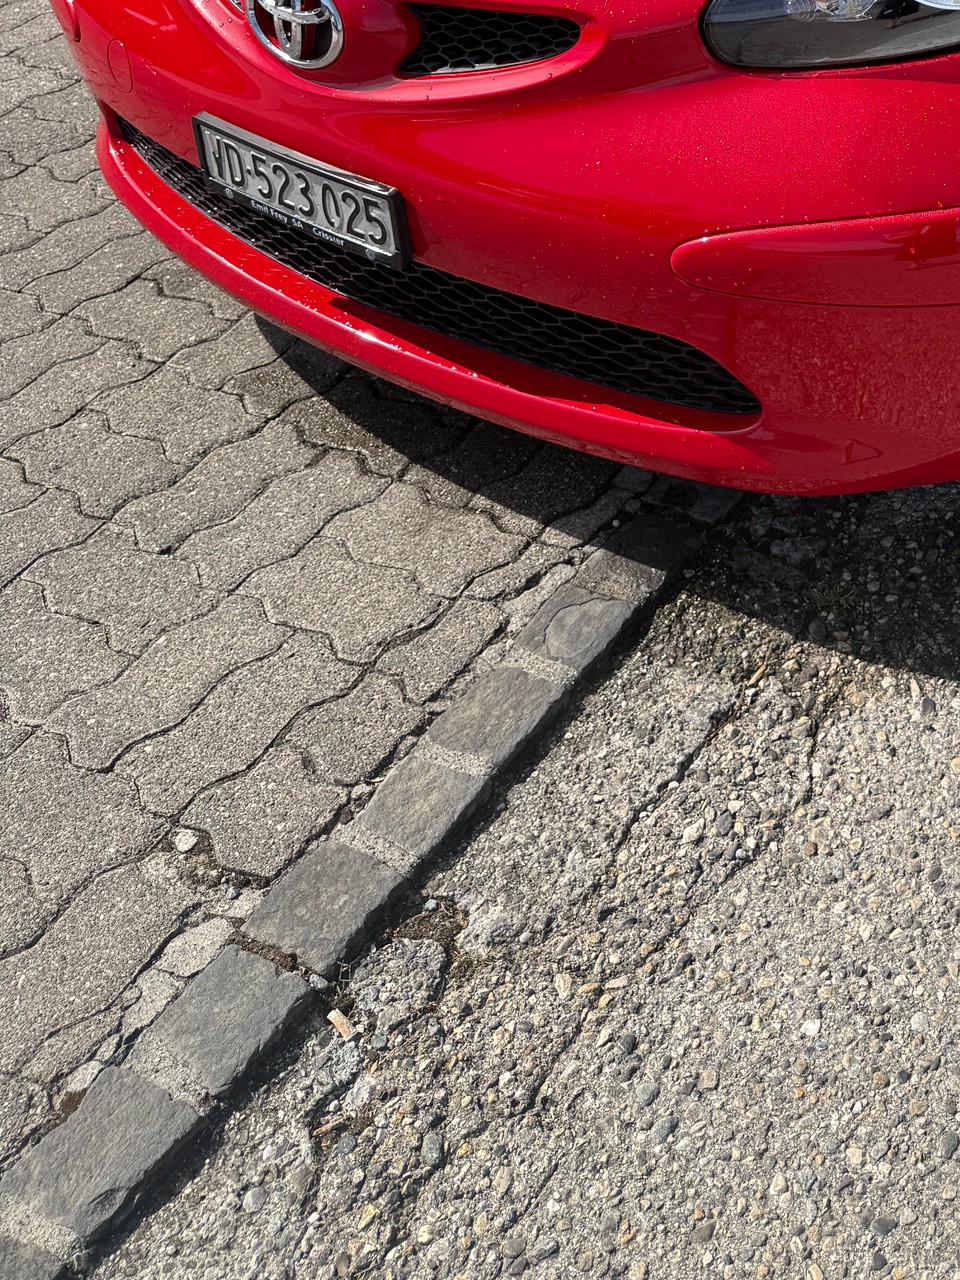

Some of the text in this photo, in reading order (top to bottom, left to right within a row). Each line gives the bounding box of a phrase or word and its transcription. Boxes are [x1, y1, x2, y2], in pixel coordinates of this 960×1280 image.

[251, 199, 345, 246] Emil Frey SA Crissier
